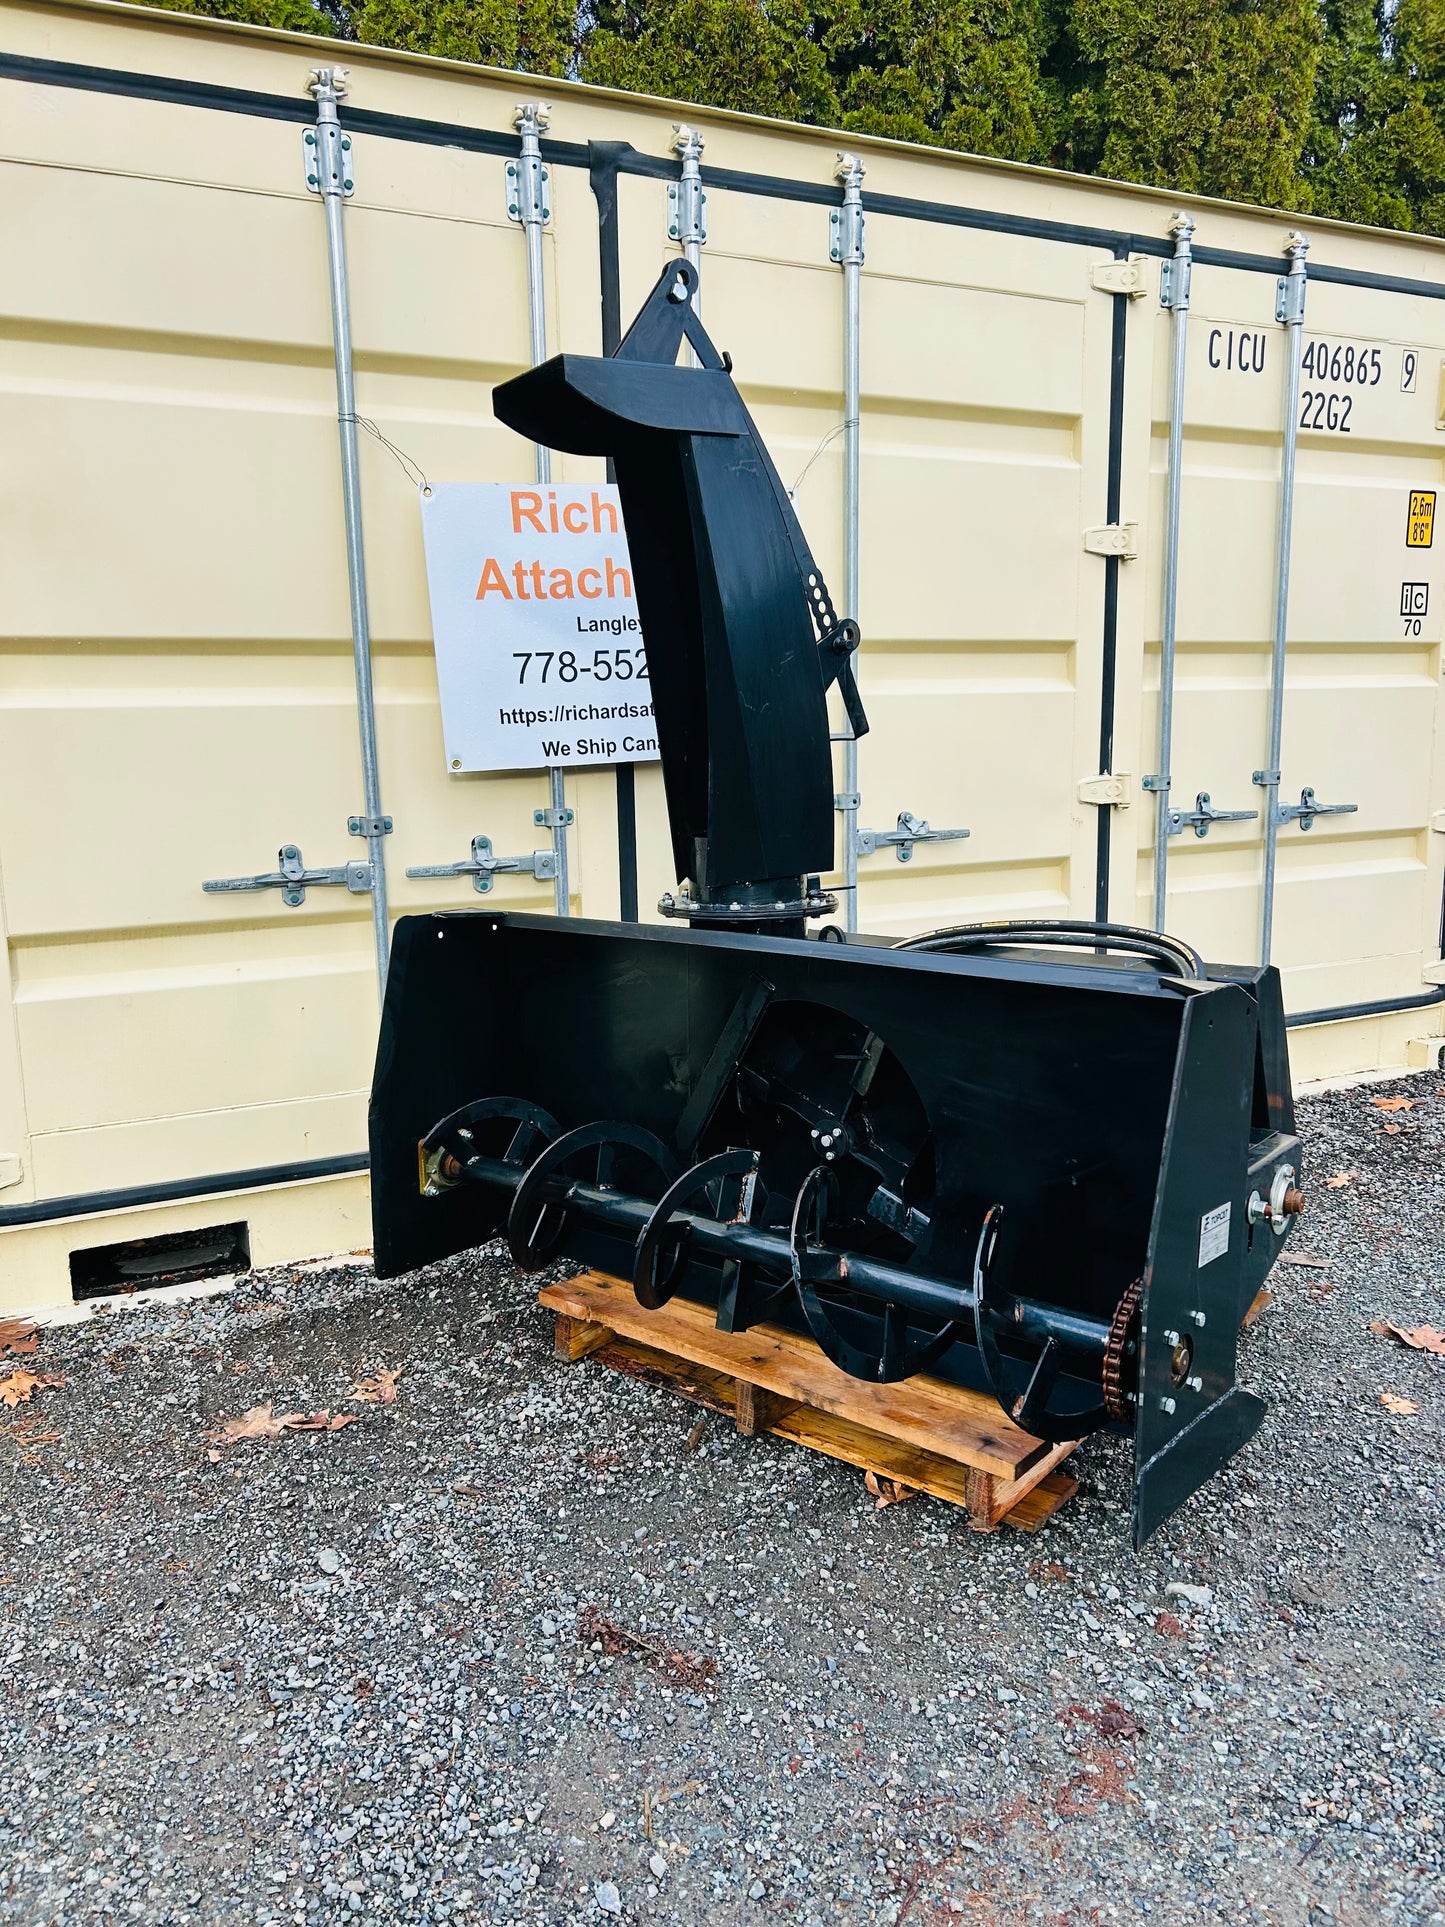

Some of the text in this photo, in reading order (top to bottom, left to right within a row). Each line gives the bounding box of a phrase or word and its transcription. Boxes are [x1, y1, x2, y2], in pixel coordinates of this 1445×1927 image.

[1208, 329, 1416, 389] CICU 406865 9
[1299, 390, 1353, 432] 22G2
[510, 491, 626, 535] Rich
[475, 557, 632, 601] Attach
[1403, 618, 1422, 637] 70
[512, 648, 650, 684] 778-552
[542, 736, 660, 757] We Ship Can
